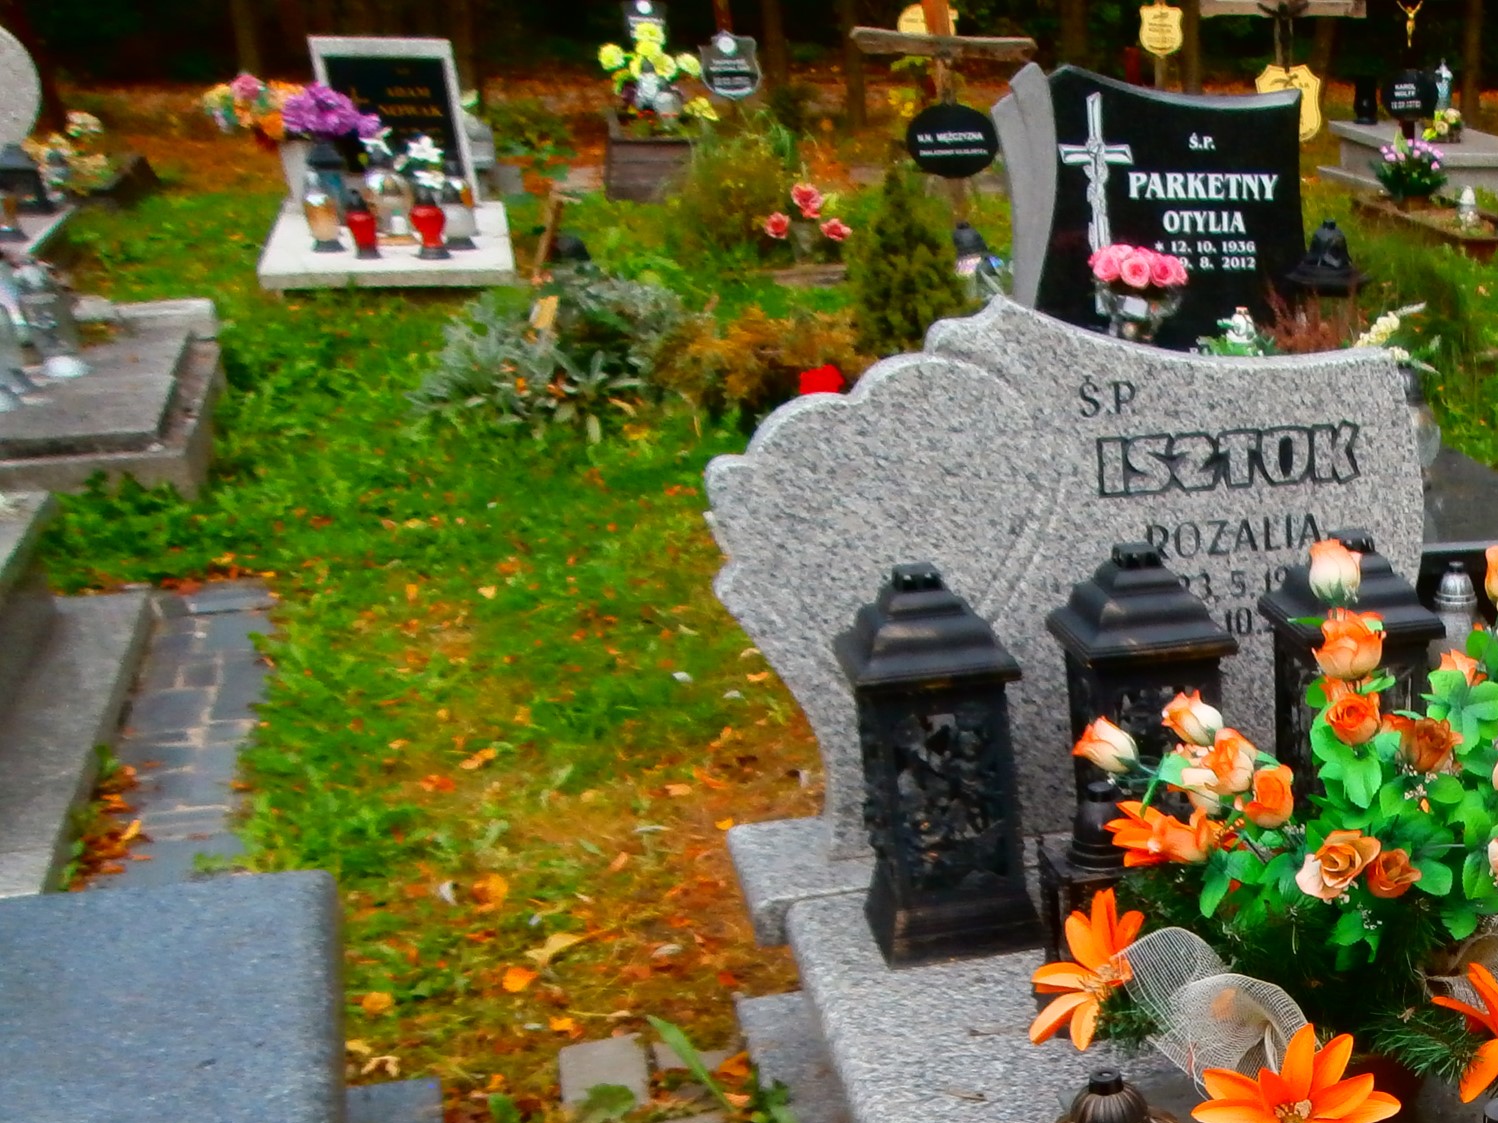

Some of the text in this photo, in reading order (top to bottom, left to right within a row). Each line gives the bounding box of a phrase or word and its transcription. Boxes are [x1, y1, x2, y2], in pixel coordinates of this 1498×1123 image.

[1128, 171, 1279, 200] PARKETNY
[1162, 210, 1246, 234] OTYLIA
[1222, 240, 1256, 254] 1936
[1221, 256, 1256, 269] 2012
[1096, 419, 1361, 498] ISZTOK
[1146, 513, 1322, 559] ROZALIA
